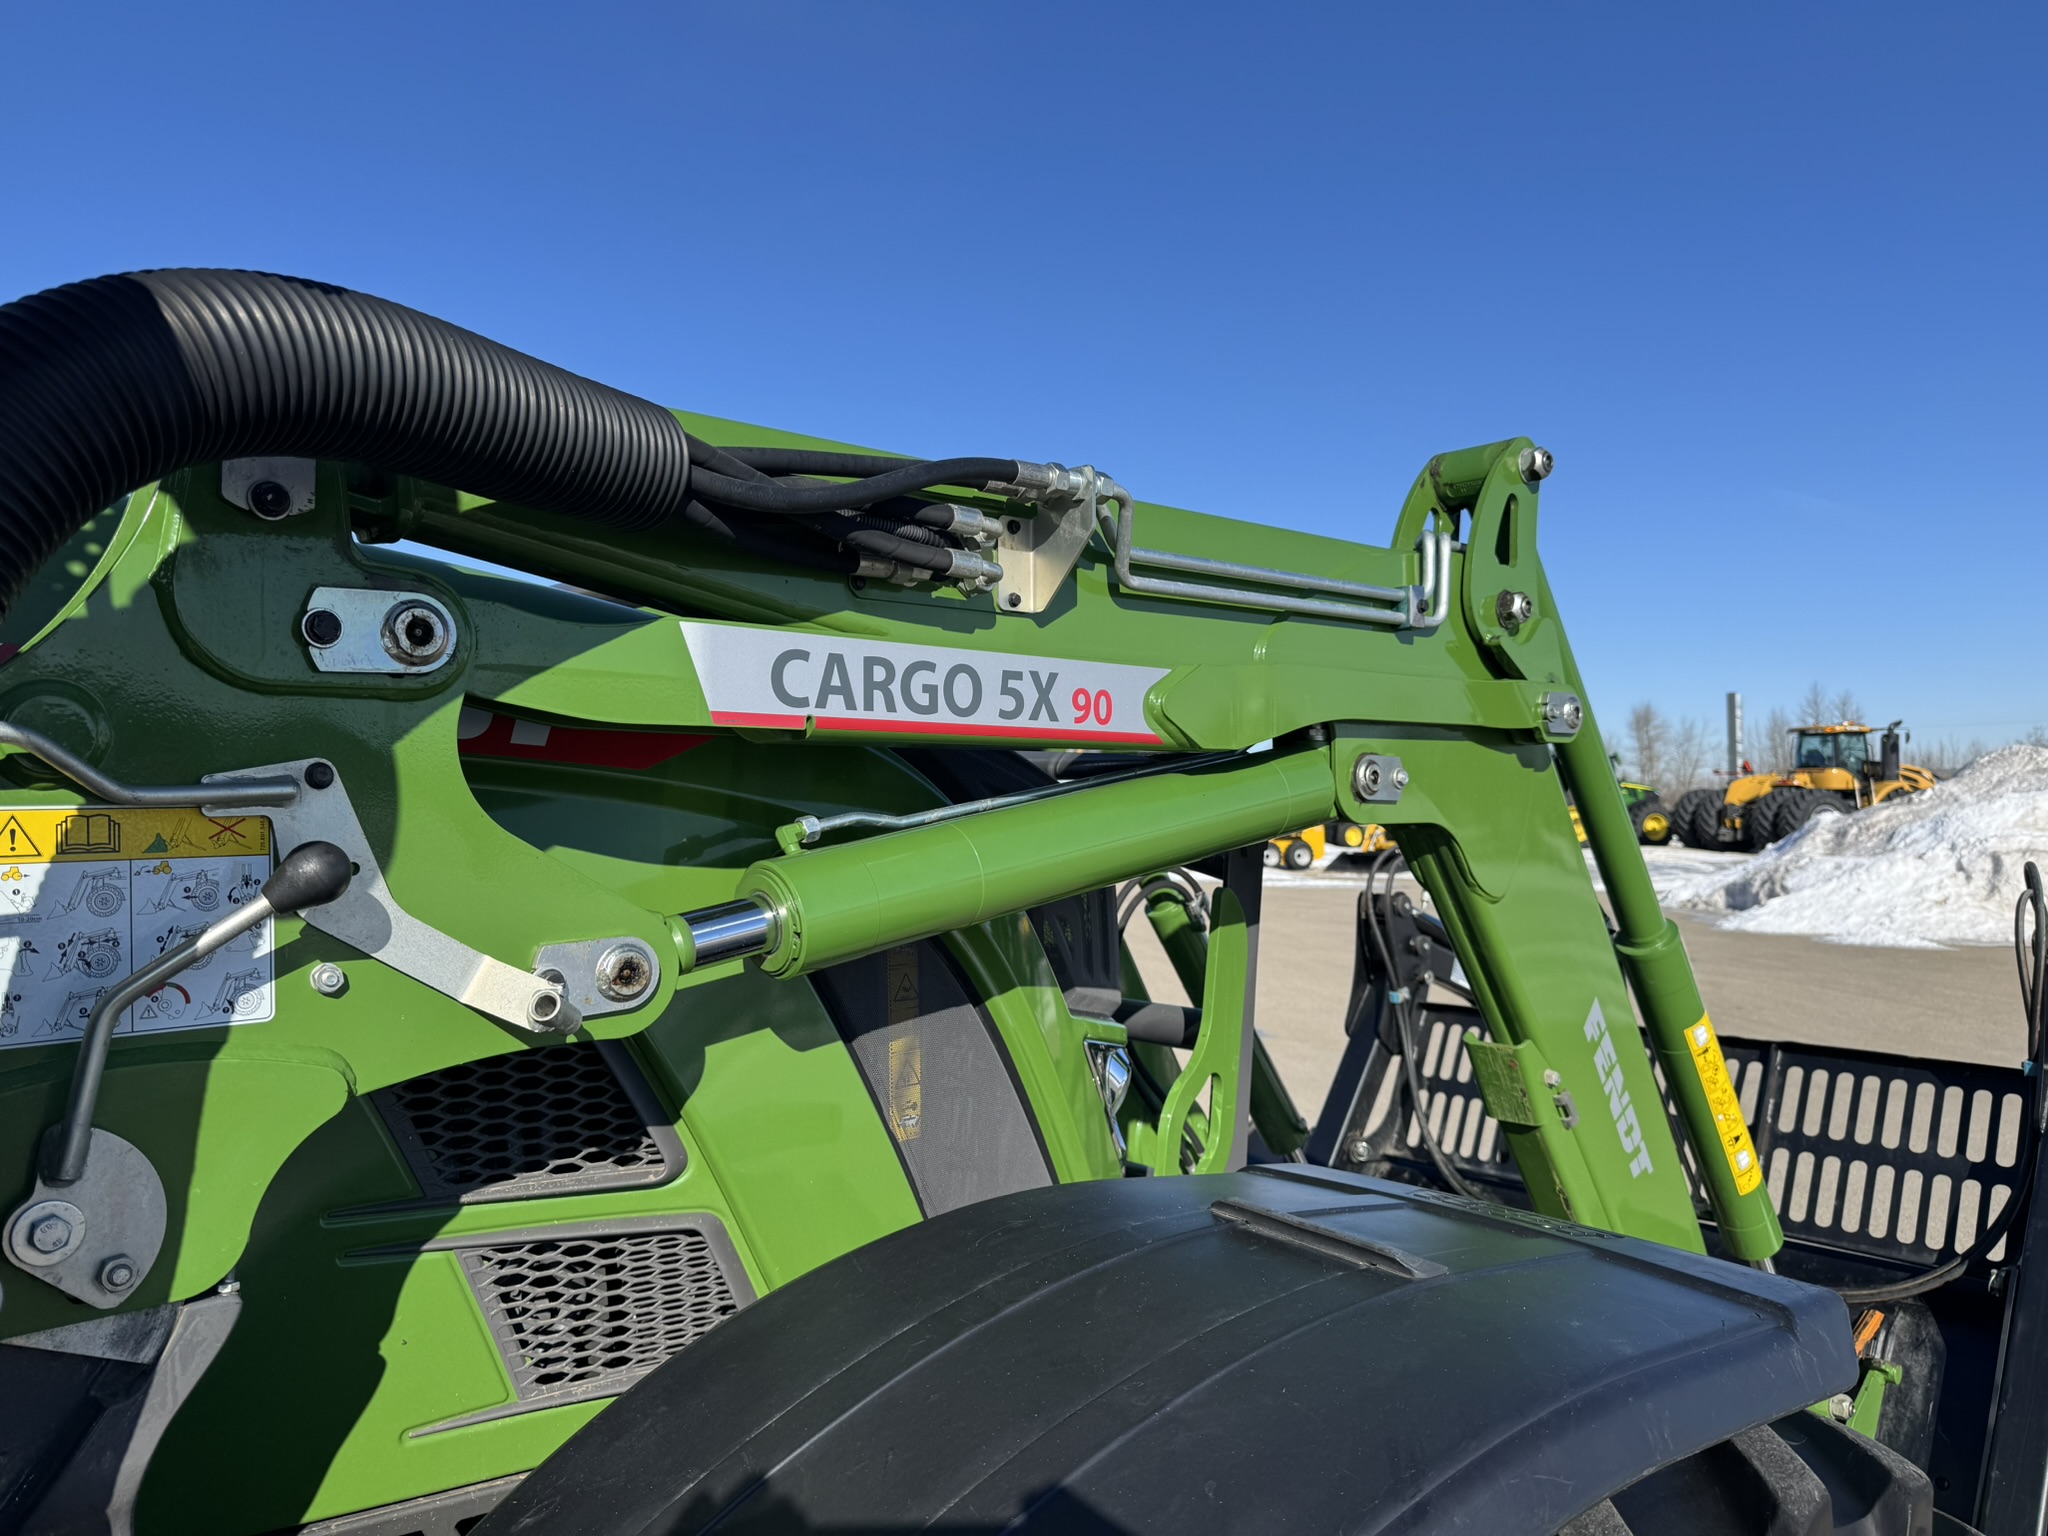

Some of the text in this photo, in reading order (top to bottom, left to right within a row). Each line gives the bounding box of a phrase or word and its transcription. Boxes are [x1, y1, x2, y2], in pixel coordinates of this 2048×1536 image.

[770, 648, 1113, 726] CARGO 5X 90
[1583, 996, 1654, 1179] FENDT
